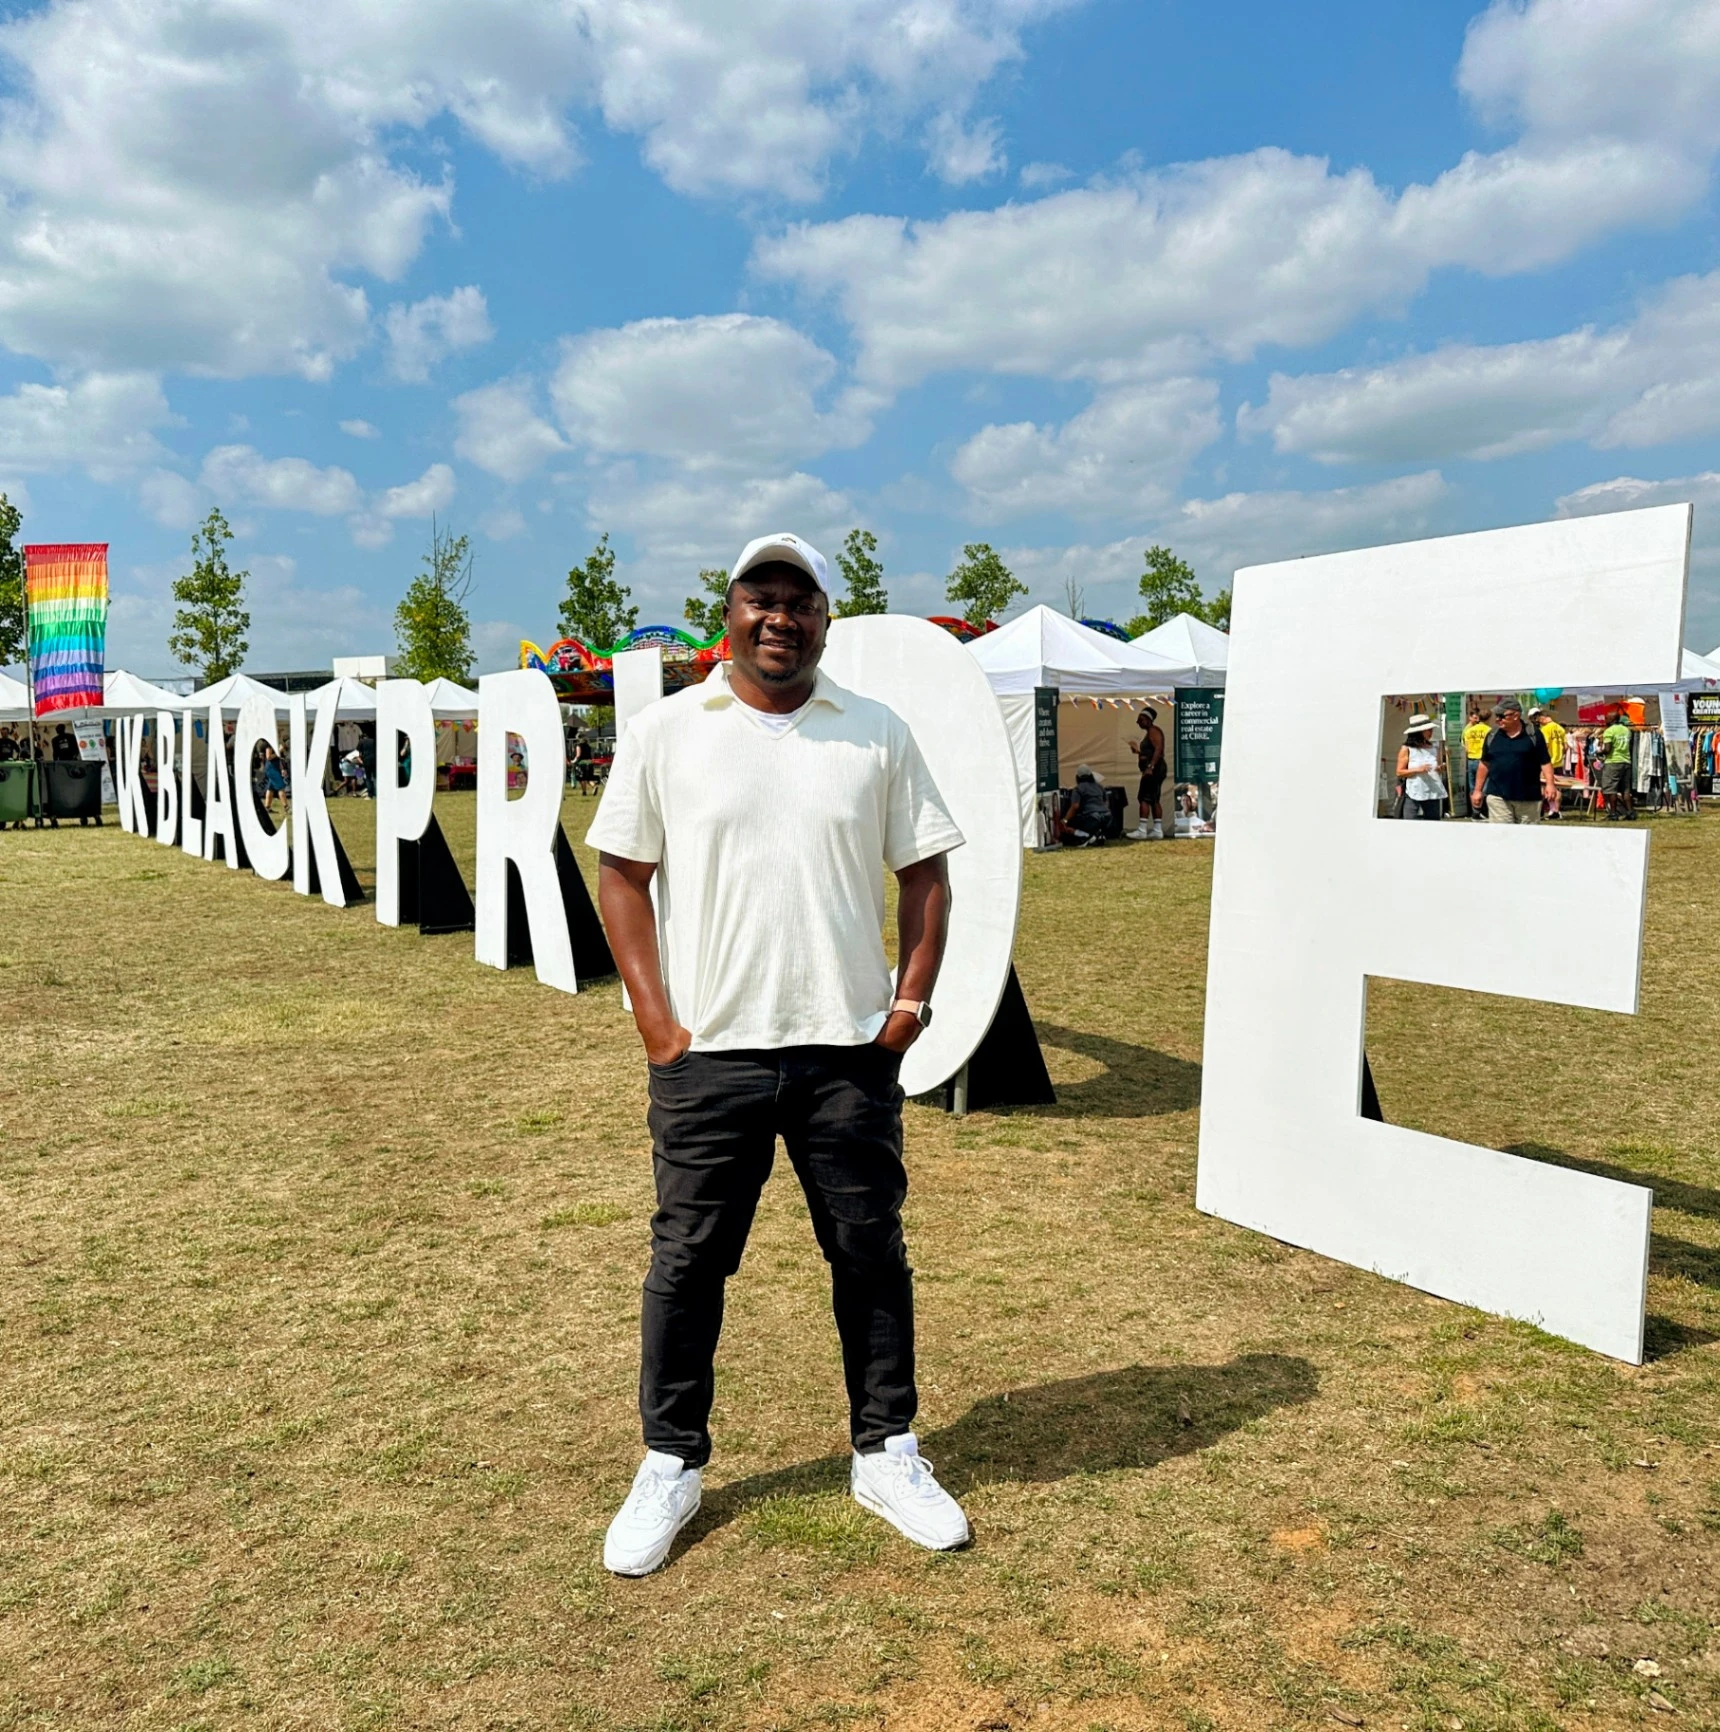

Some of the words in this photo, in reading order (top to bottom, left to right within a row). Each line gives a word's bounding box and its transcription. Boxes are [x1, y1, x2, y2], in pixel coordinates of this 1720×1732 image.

[1181, 701, 1205, 710] Explore
[1181, 716, 1218, 724] commercial
[116, 713, 149, 838] UK
[156, 686, 346, 908] BLACK
